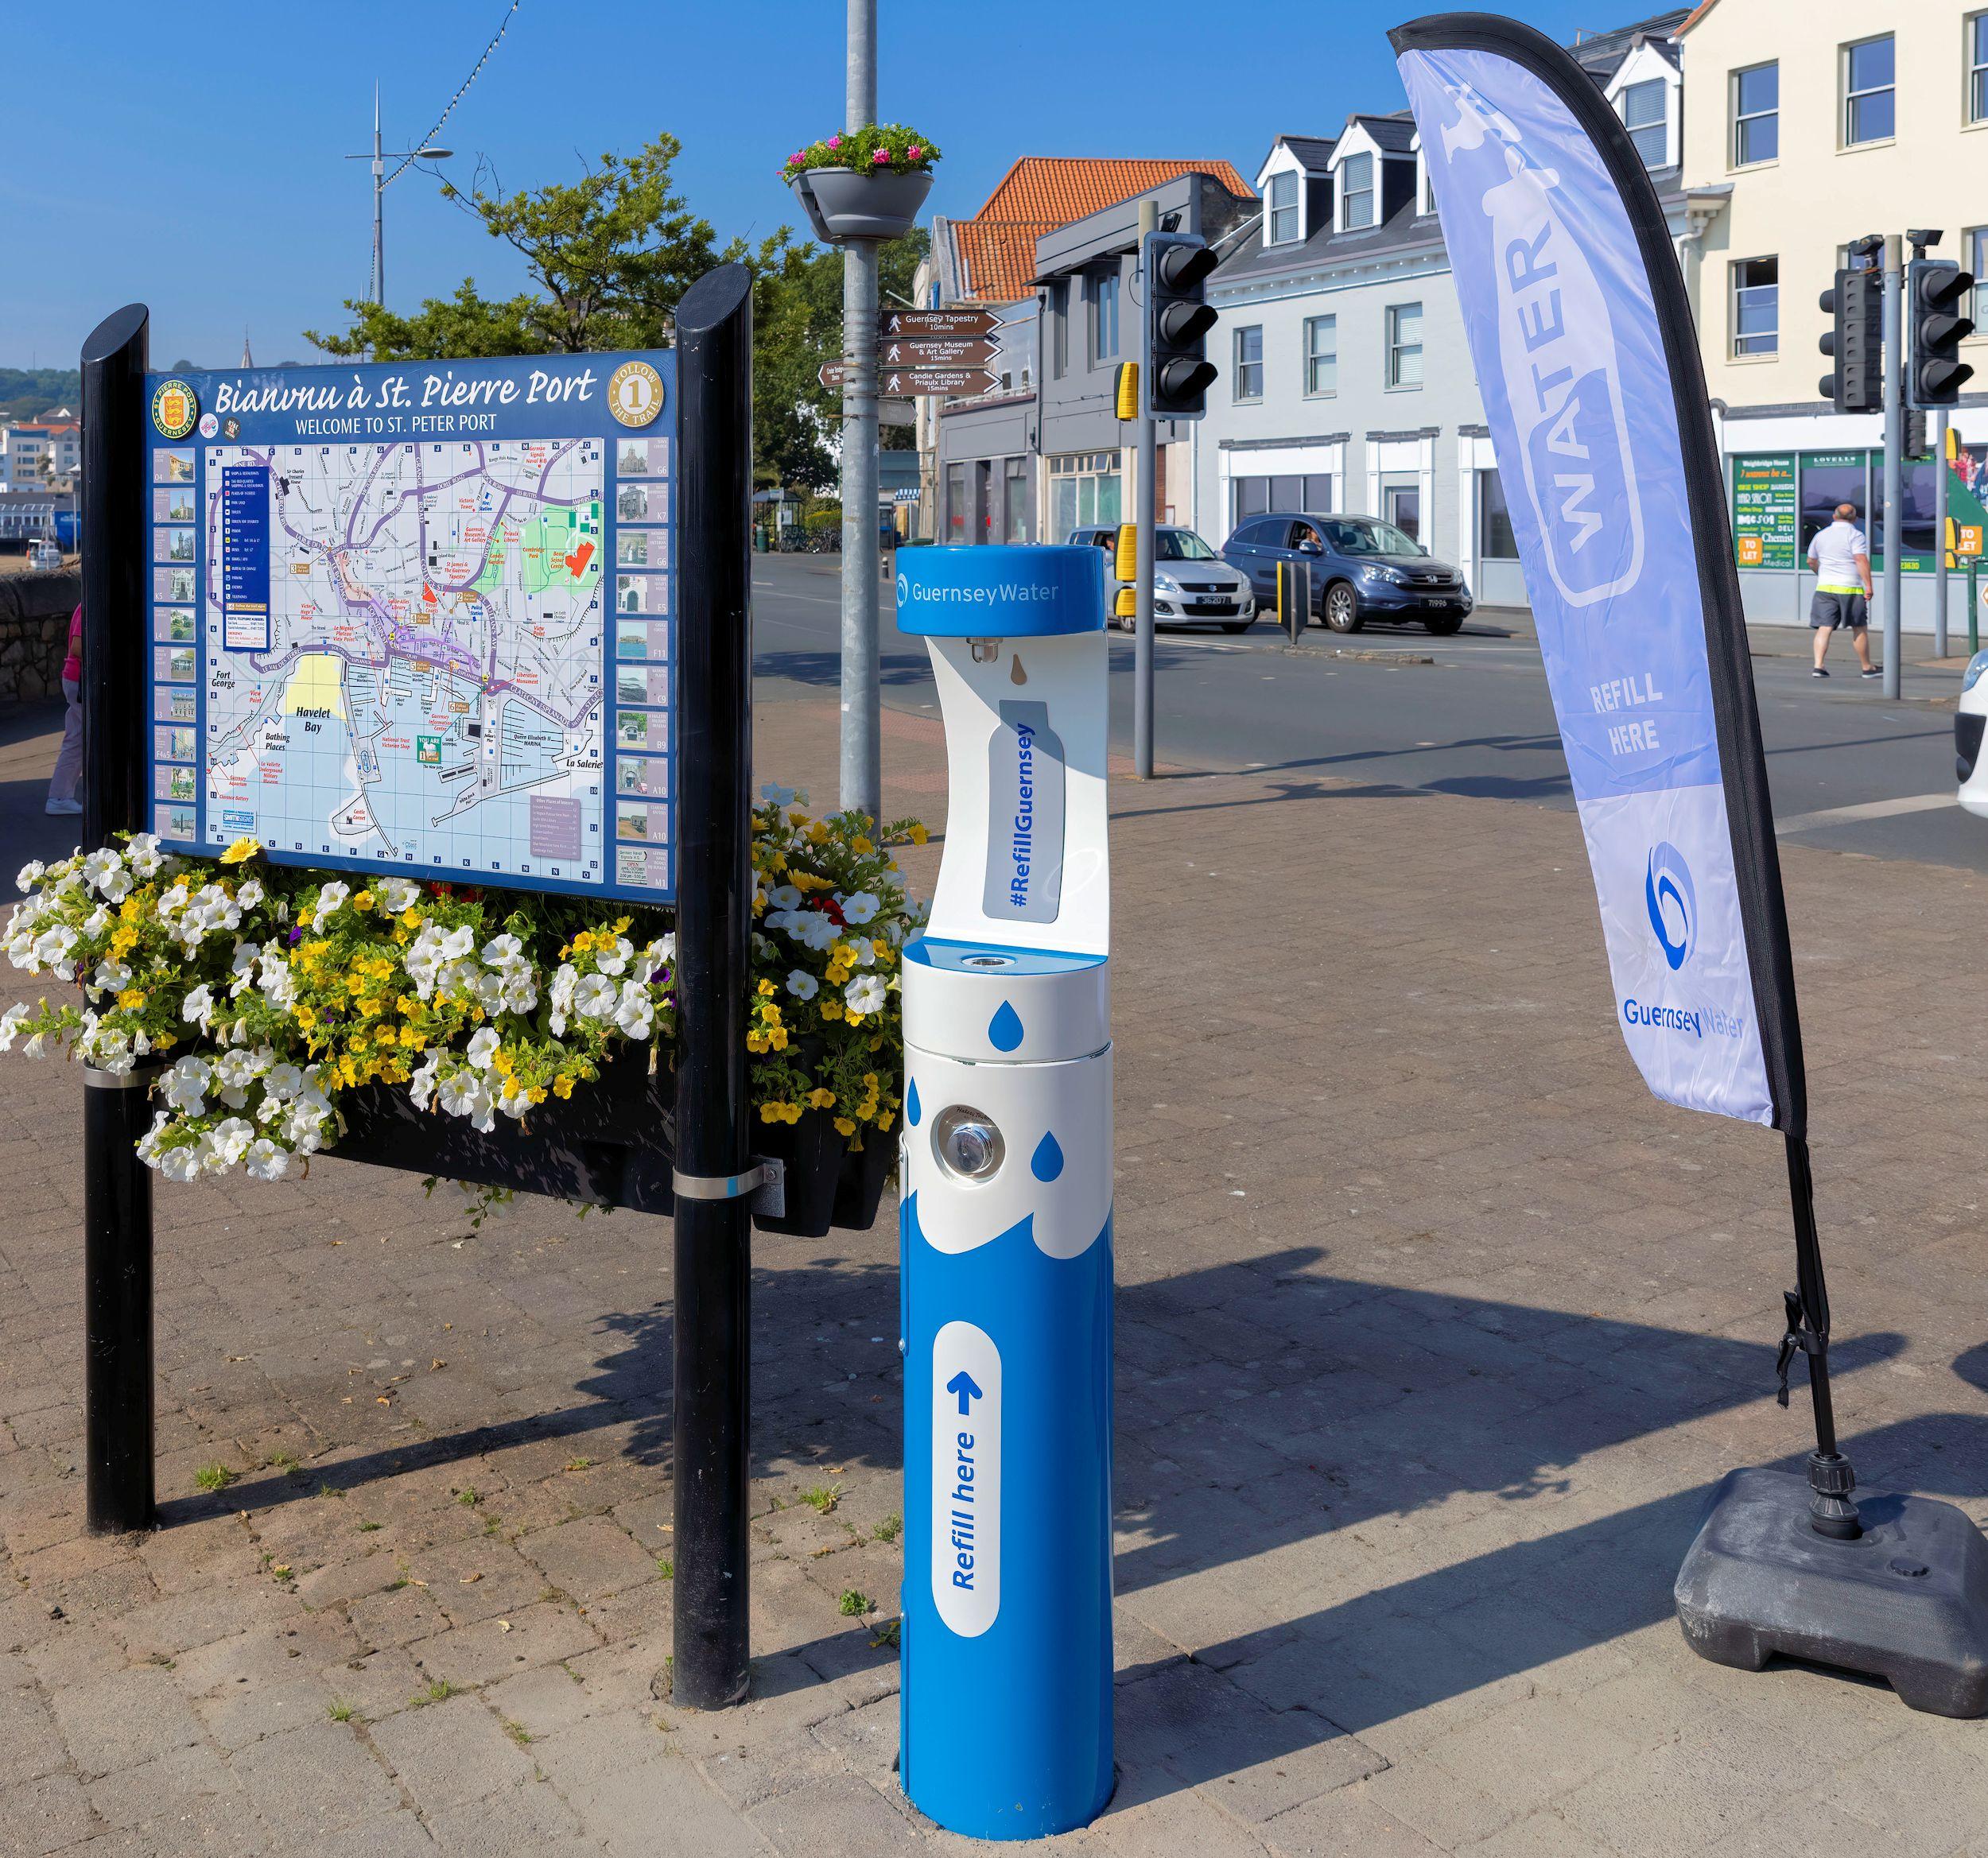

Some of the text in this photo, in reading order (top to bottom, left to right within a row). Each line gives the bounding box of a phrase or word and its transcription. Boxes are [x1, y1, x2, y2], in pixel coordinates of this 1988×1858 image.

[615, 365, 657, 385] FOLLOW
[215, 368, 598, 413] Bianvnu à St. Pierre Port
[1504, 219, 1604, 555] WATER
[153, 382, 195, 409] ST PIERRE PORT
[628, 379, 642, 408] 1
[612, 399, 661, 425] THE TRAIL
[295, 413, 497, 435] WELCOME TO ST. PETER PORT
[1761, 532, 1794, 543] Chemist
[1960, 529, 1974, 539] TO
[1744, 540, 1757, 549] TO
[1742, 551, 1757, 561] LET
[658, 603, 666, 612] E5
[216, 670, 231, 680] Fort
[212, 679, 235, 689] George
[657, 695, 666, 704] C9
[1590, 673, 1664, 714] REFILL
[296, 706, 331, 719] Havelet
[305, 721, 322, 735] Bay
[266, 732, 290, 743] Bathing
[1607, 720, 1660, 756] HERE
[266, 743, 285, 751] Places
[566, 758, 577, 767] La
[652, 786, 666, 795] A10
[1010, 723, 1035, 907] #RefillGuernsey
[654, 879, 666, 887] M1
[951, 1432, 975, 1590] Refill here
